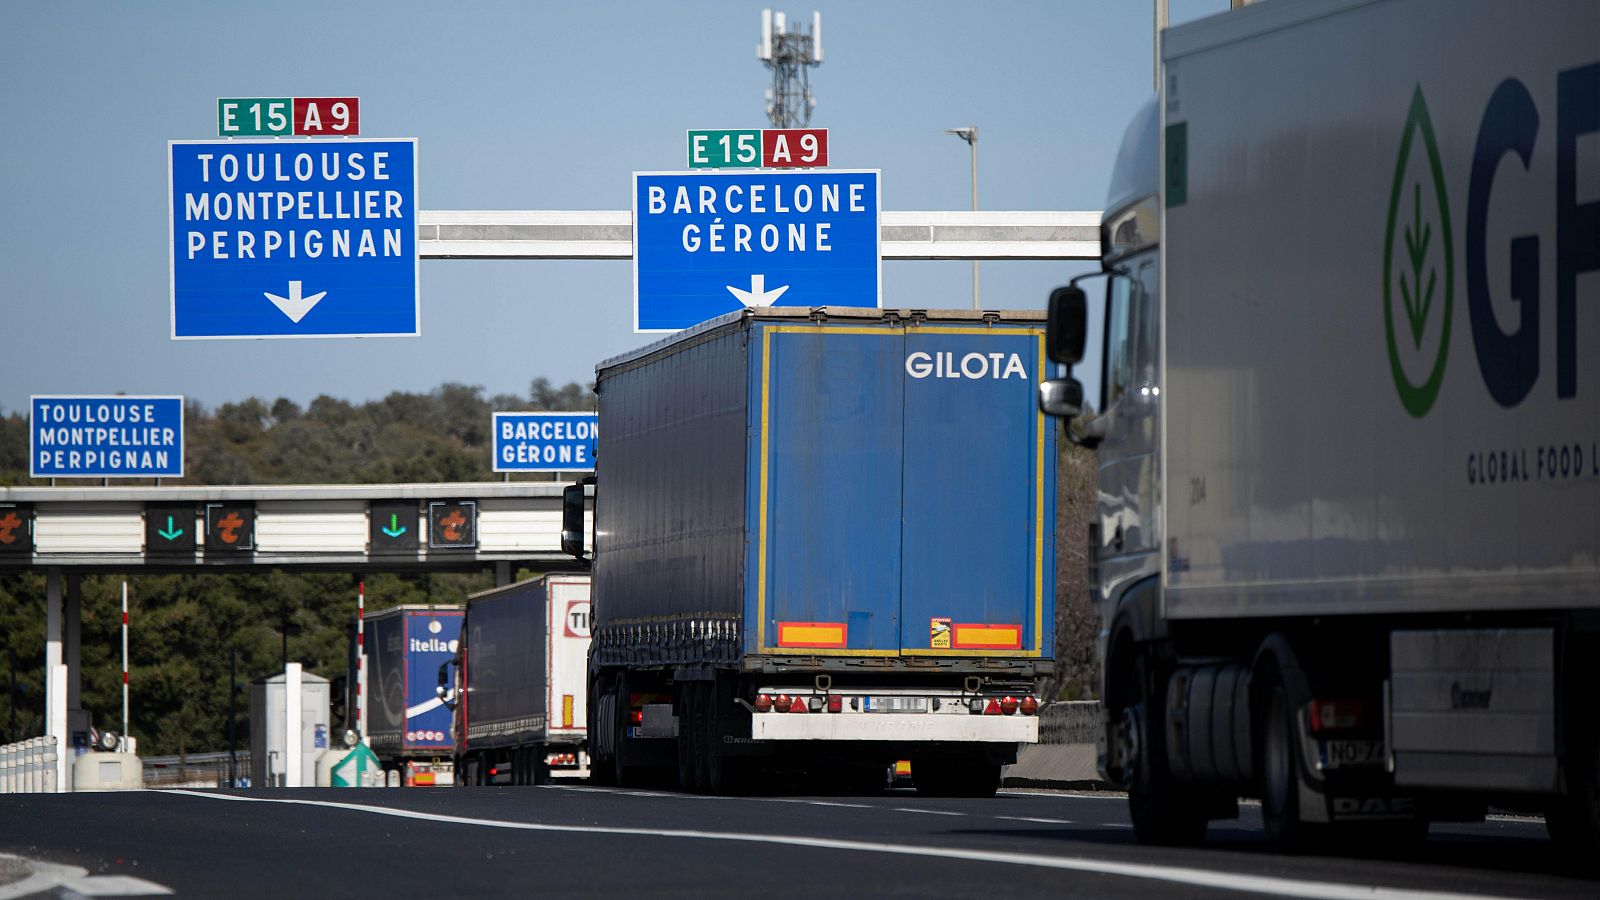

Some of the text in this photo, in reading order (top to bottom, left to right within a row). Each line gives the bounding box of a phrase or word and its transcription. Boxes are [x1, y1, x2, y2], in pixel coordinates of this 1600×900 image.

[223, 103, 287, 131] E 15
[303, 102, 350, 131] A 9
[693, 135, 756, 163] E 15
[773, 134, 818, 162] A 9
[197, 152, 390, 182] TOULOUSE
[185, 190, 403, 221] MONTPELLIER
[648, 184, 865, 214] BARCELONE
[188, 228, 402, 259] PERPIGNAN
[682, 218, 832, 252] GÉRONE
[905, 351, 1027, 380] GILOTA
[40, 404, 155, 423] TOULOUSE
[40, 427, 175, 446] MONTPELLIER
[40, 450, 168, 469] PERPIGNAN
[502, 442, 586, 463] GÉRONE
[1467, 452, 1529, 485] GLOBAL
[1537, 444, 1583, 480] FOOD
[570, 612, 590, 628] TI
[410, 638, 447, 652] itella
[1331, 743, 1357, 762] NO
[1333, 797, 1415, 815] DAF
